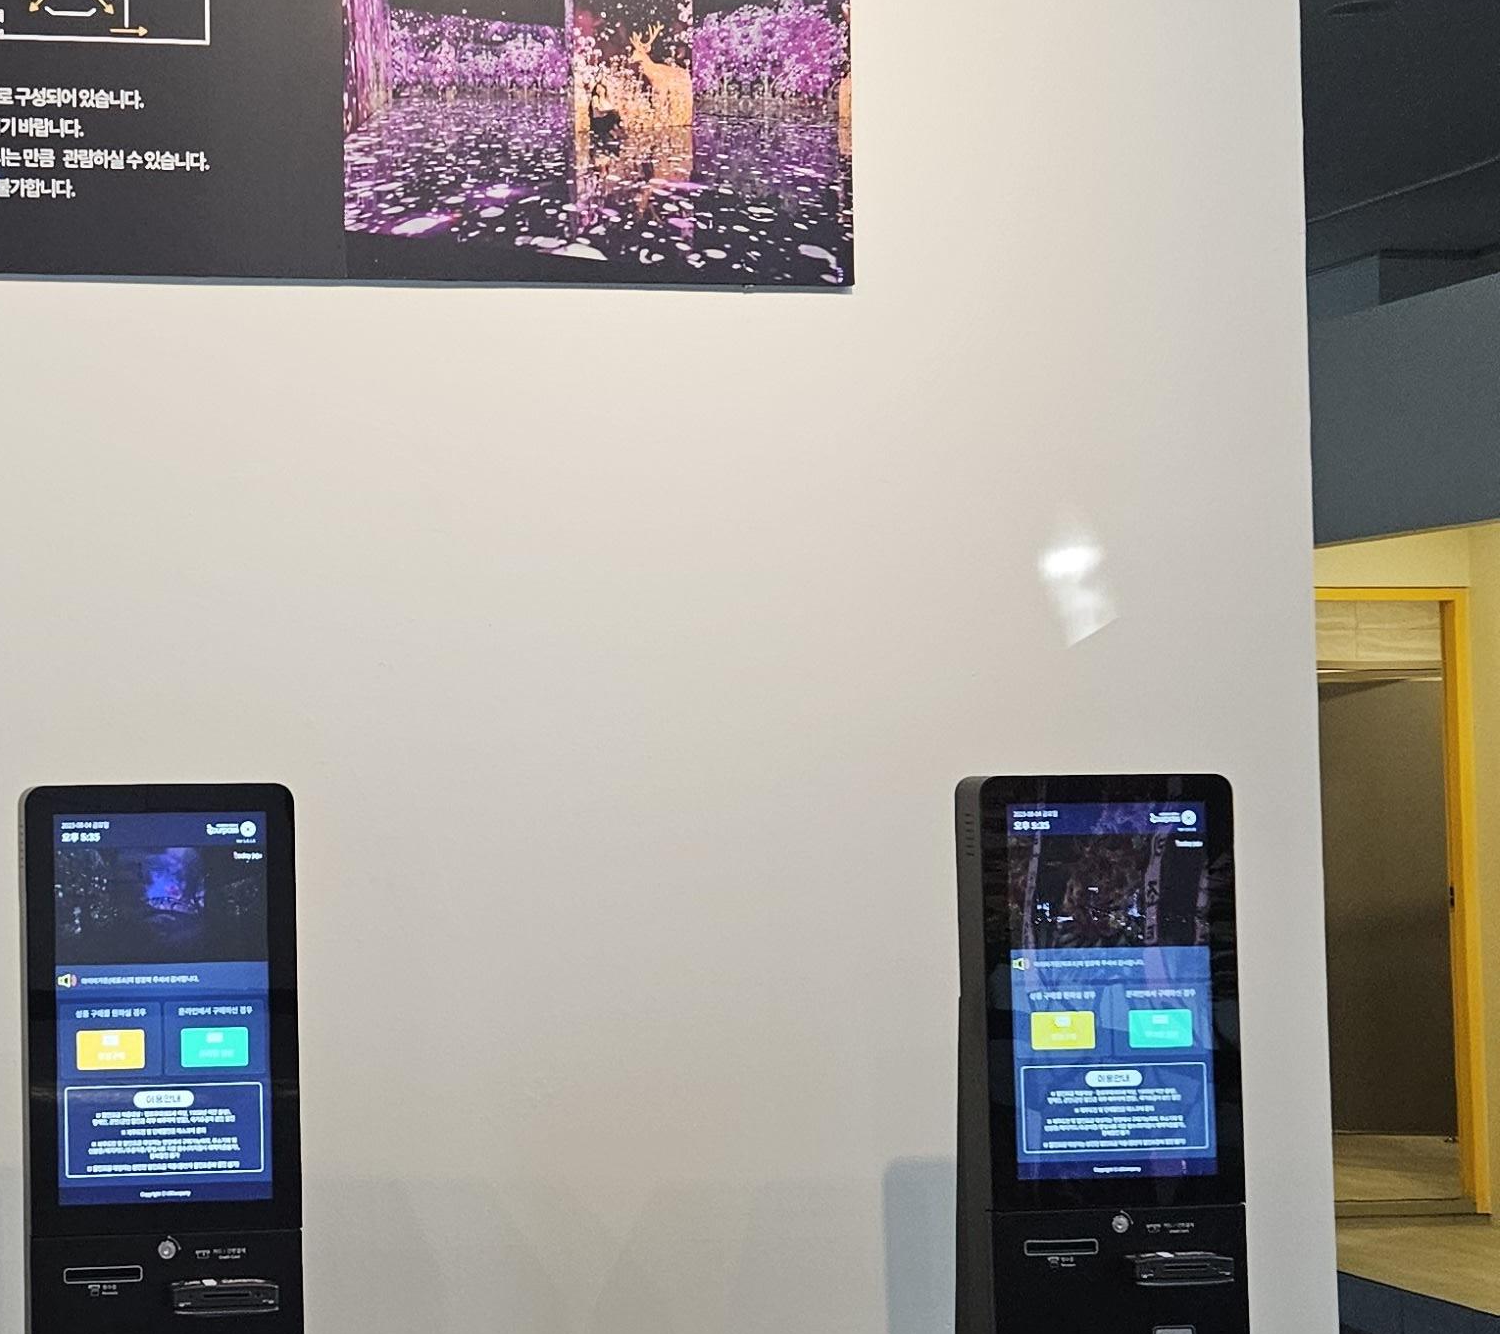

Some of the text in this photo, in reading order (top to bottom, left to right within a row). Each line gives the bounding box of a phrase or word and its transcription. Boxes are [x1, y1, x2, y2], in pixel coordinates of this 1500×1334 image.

[15, 87, 77, 108] 구성되어
[78, 89, 145, 110] 있습니다.
[17, 117, 84, 138] 바랍니다.
[22, 148, 55, 168] 만큼
[62, 149, 125, 170] 관람하실
[126, 151, 143, 170] 수
[144, 151, 211, 171] 있습니다.
